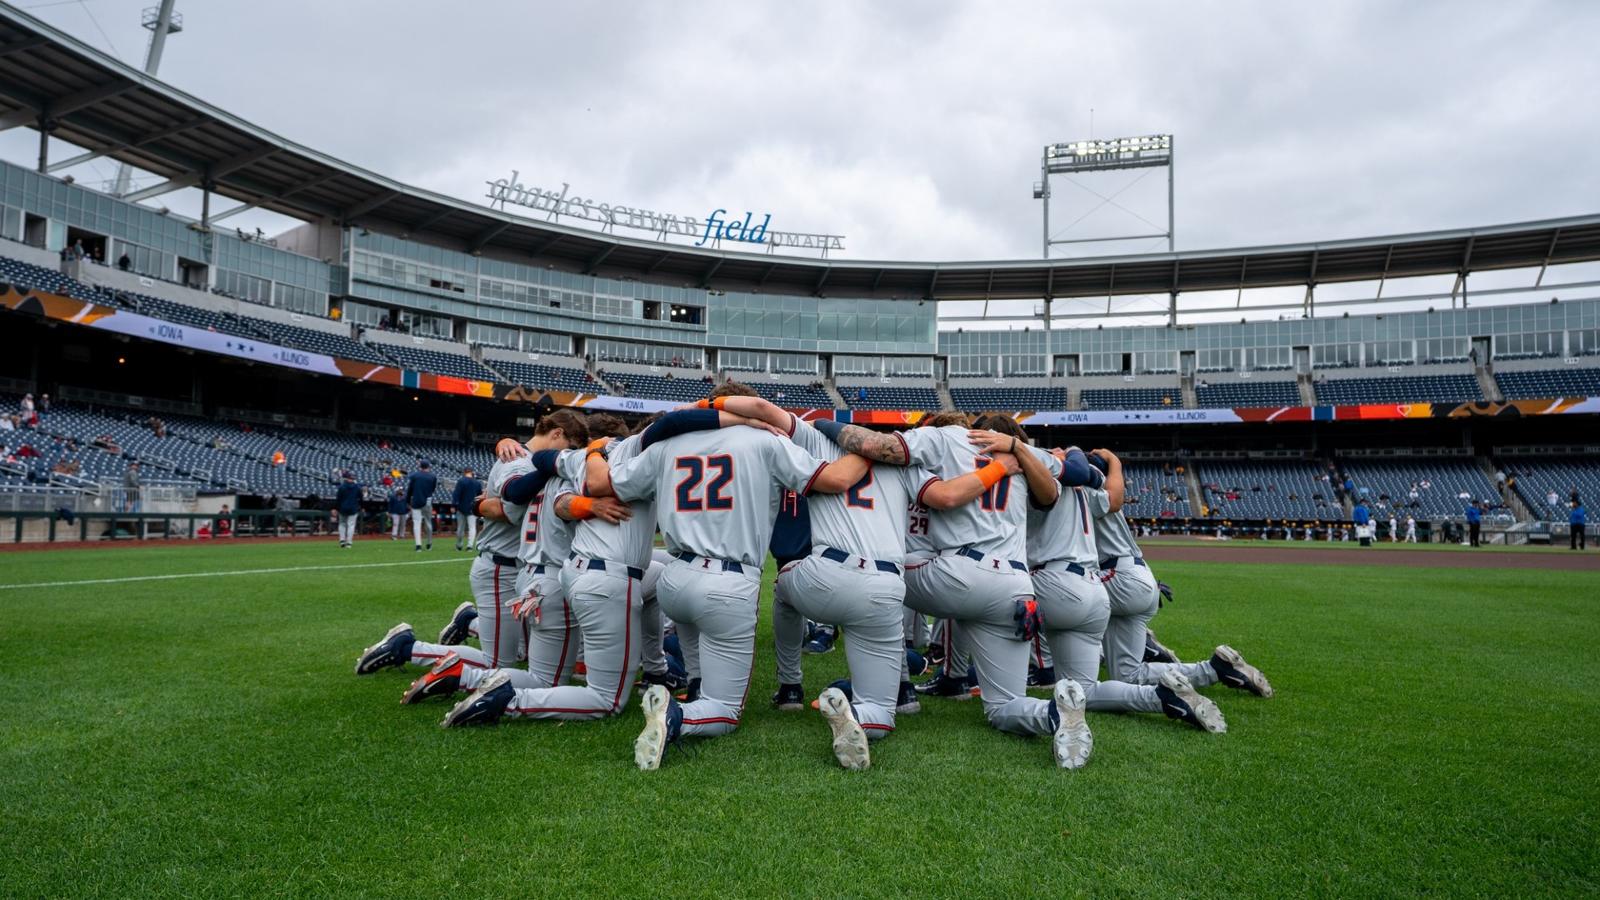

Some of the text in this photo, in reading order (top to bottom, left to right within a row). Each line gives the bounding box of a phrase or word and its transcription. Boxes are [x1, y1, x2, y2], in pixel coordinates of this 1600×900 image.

[490, 169, 842, 250] charles SCHWAB field OMAHA
[157, 324, 183, 341] IOWA
[281, 351, 310, 366] ILLINOIS
[626, 400, 644, 410] IOWA
[1067, 413, 1088, 422] IOWA
[1176, 411, 1207, 421] ILLINOIS
[675, 453, 734, 513] 22
[909, 515, 929, 535] 29
[702, 558, 711, 569] I
[857, 557, 866, 569] I
[992, 558, 1000, 570] I
